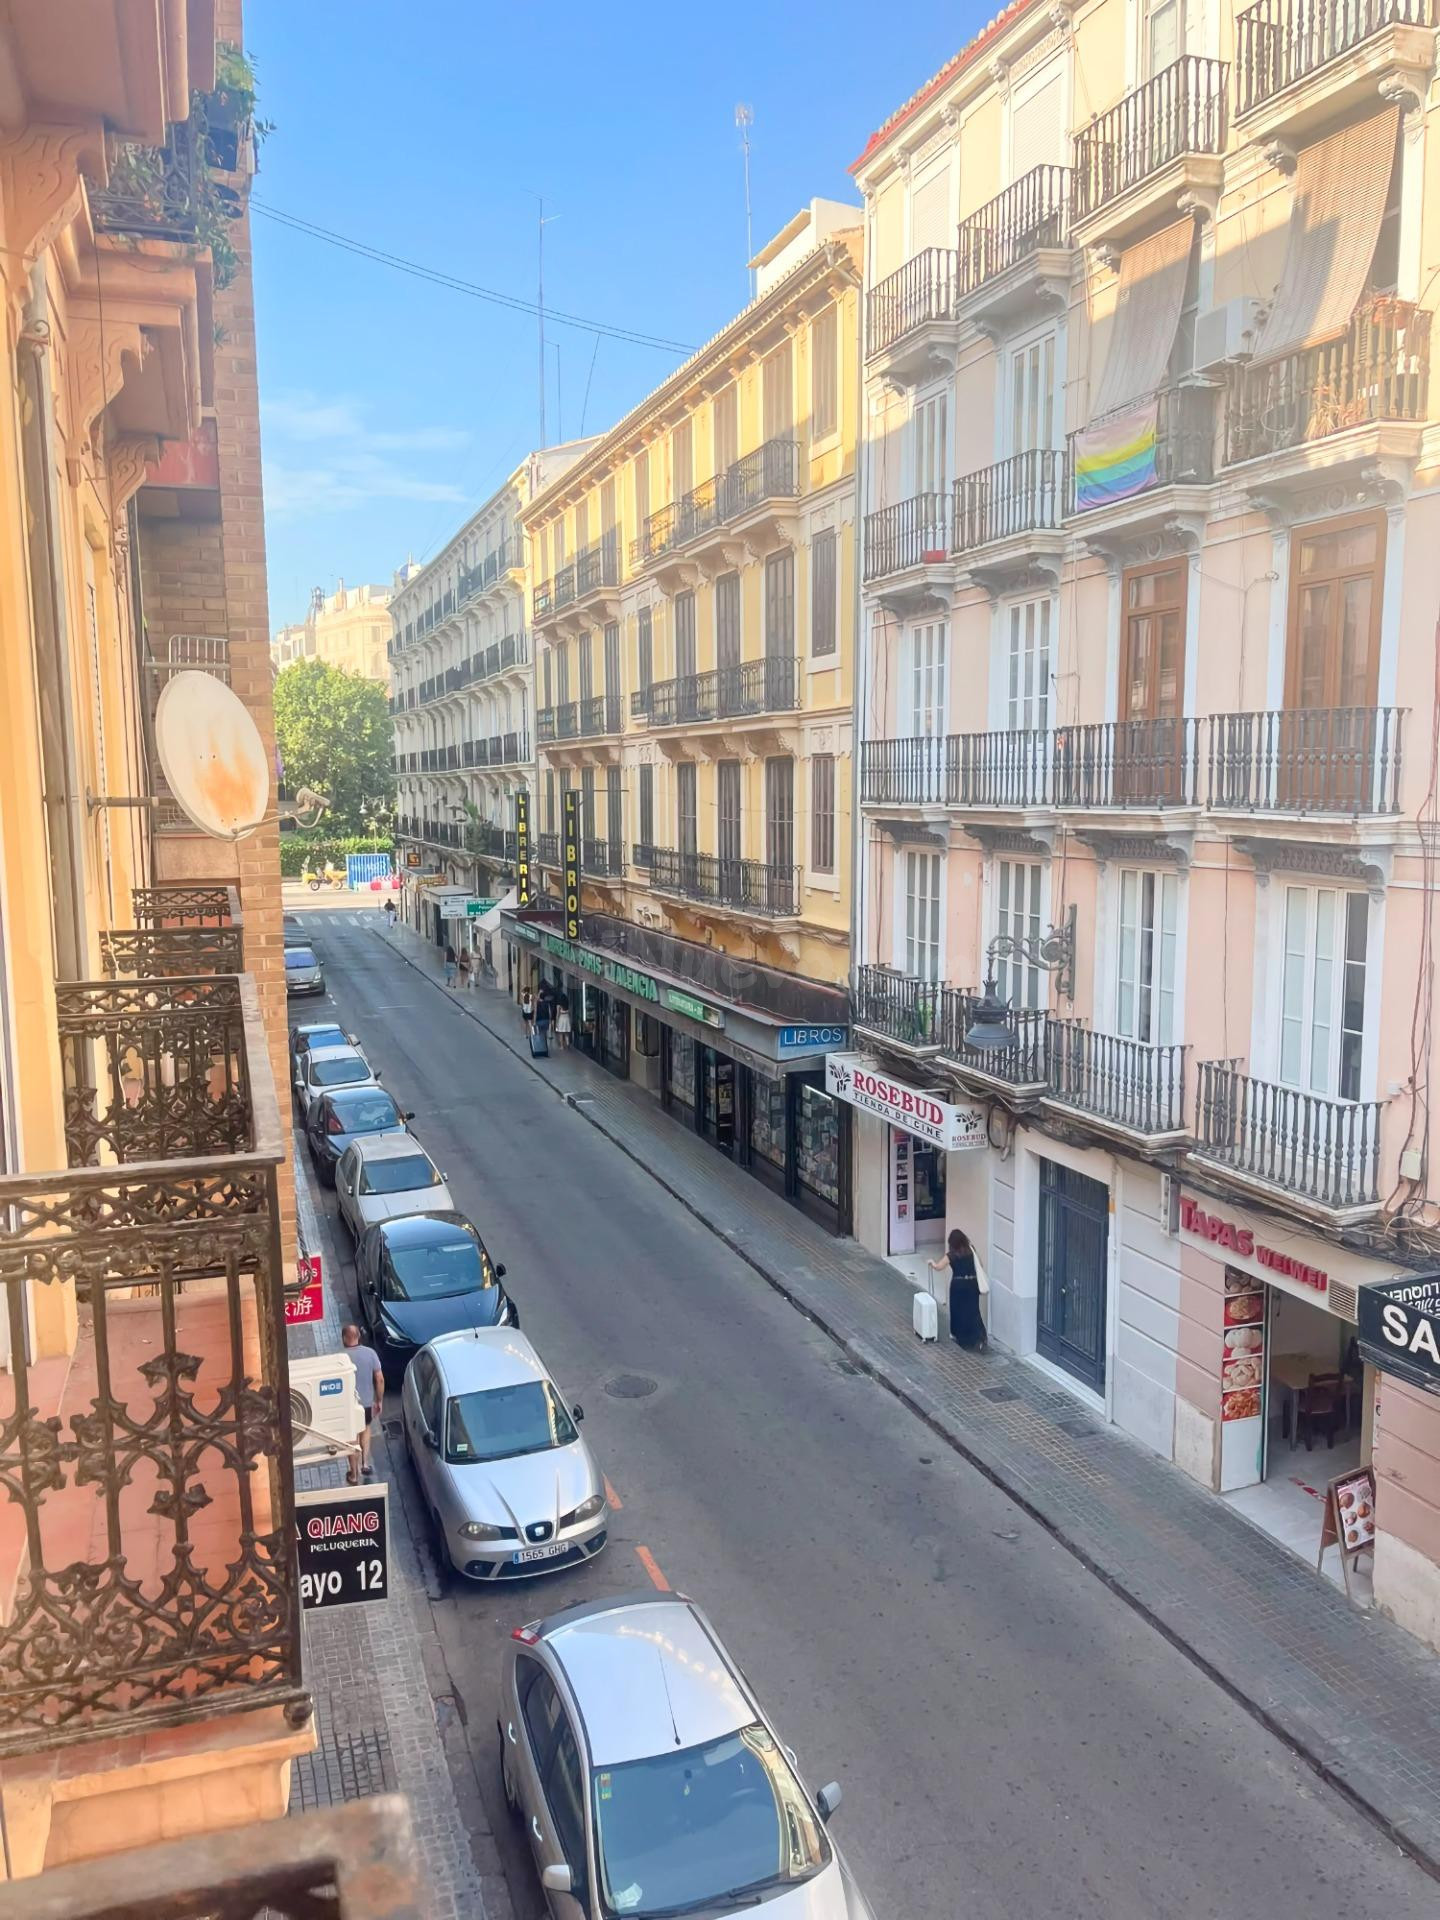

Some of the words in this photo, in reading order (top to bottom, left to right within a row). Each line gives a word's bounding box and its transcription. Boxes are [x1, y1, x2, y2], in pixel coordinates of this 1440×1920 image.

[518, 794, 529, 903] LIBRERIA
[566, 793, 578, 938] LIBROS
[784, 1028, 842, 1045] LIBROS
[853, 1069, 944, 1125] ROSEBUD
[853, 1092, 890, 1115] TIENDA
[895, 1111, 909, 1123] DE
[914, 1120, 942, 1139] CINE
[1180, 1196, 1254, 1256] TAPAS
[1256, 1245, 1328, 1291] WEIWEI
[307, 1511, 380, 1539] QIANG
[310, 1538, 379, 1552] PELUQUERIA
[522, 1550, 544, 1560] 1565
[356, 1559, 383, 1590] 12
